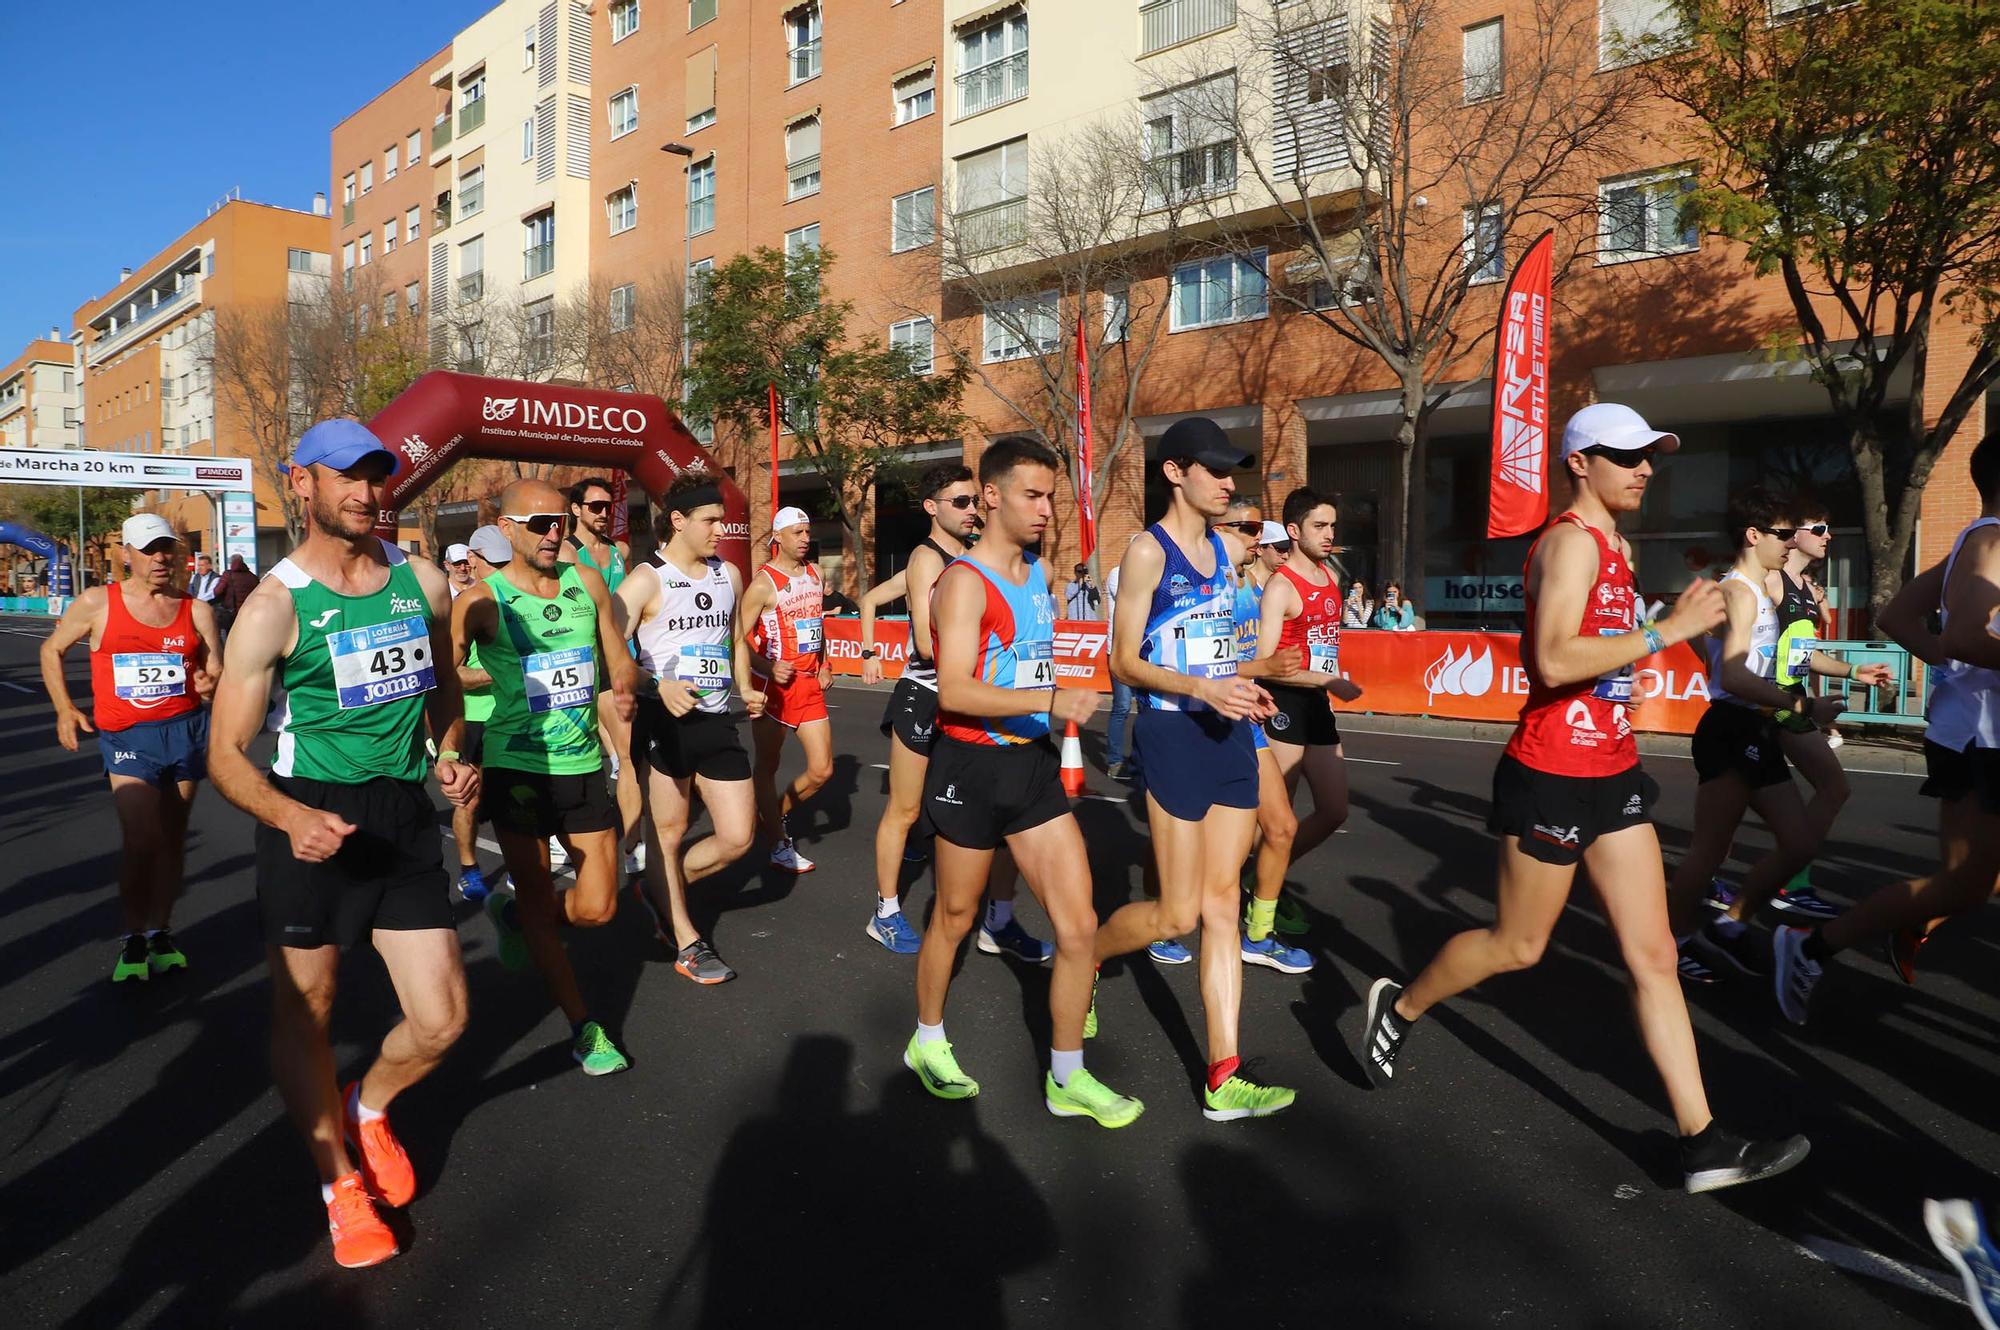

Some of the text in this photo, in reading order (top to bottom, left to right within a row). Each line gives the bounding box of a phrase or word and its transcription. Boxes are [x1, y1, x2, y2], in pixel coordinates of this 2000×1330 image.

[1531, 292, 1546, 424] ATLETISMO
[522, 398, 647, 434] IMDECO
[481, 425, 644, 448] Instituto Municipal de Deportes Córdoba
[16, 457, 79, 473] Marcha
[83, 460, 104, 473] 20
[109, 462, 135, 474] km
[392, 460, 432, 499] AYUNTAMIENTO
[430, 455, 439, 465] DE
[1445, 579, 1523, 600] house
[163, 637, 185, 647] UAR
[810, 628, 821, 641] 20
[1213, 638, 1231, 660] 27
[370, 646, 406, 676] 43
[699, 658, 718, 675] 30
[1034, 661, 1052, 682] 41
[1322, 659, 1334, 674] 42
[138, 667, 163, 683] 52
[551, 667, 579, 689] 45
